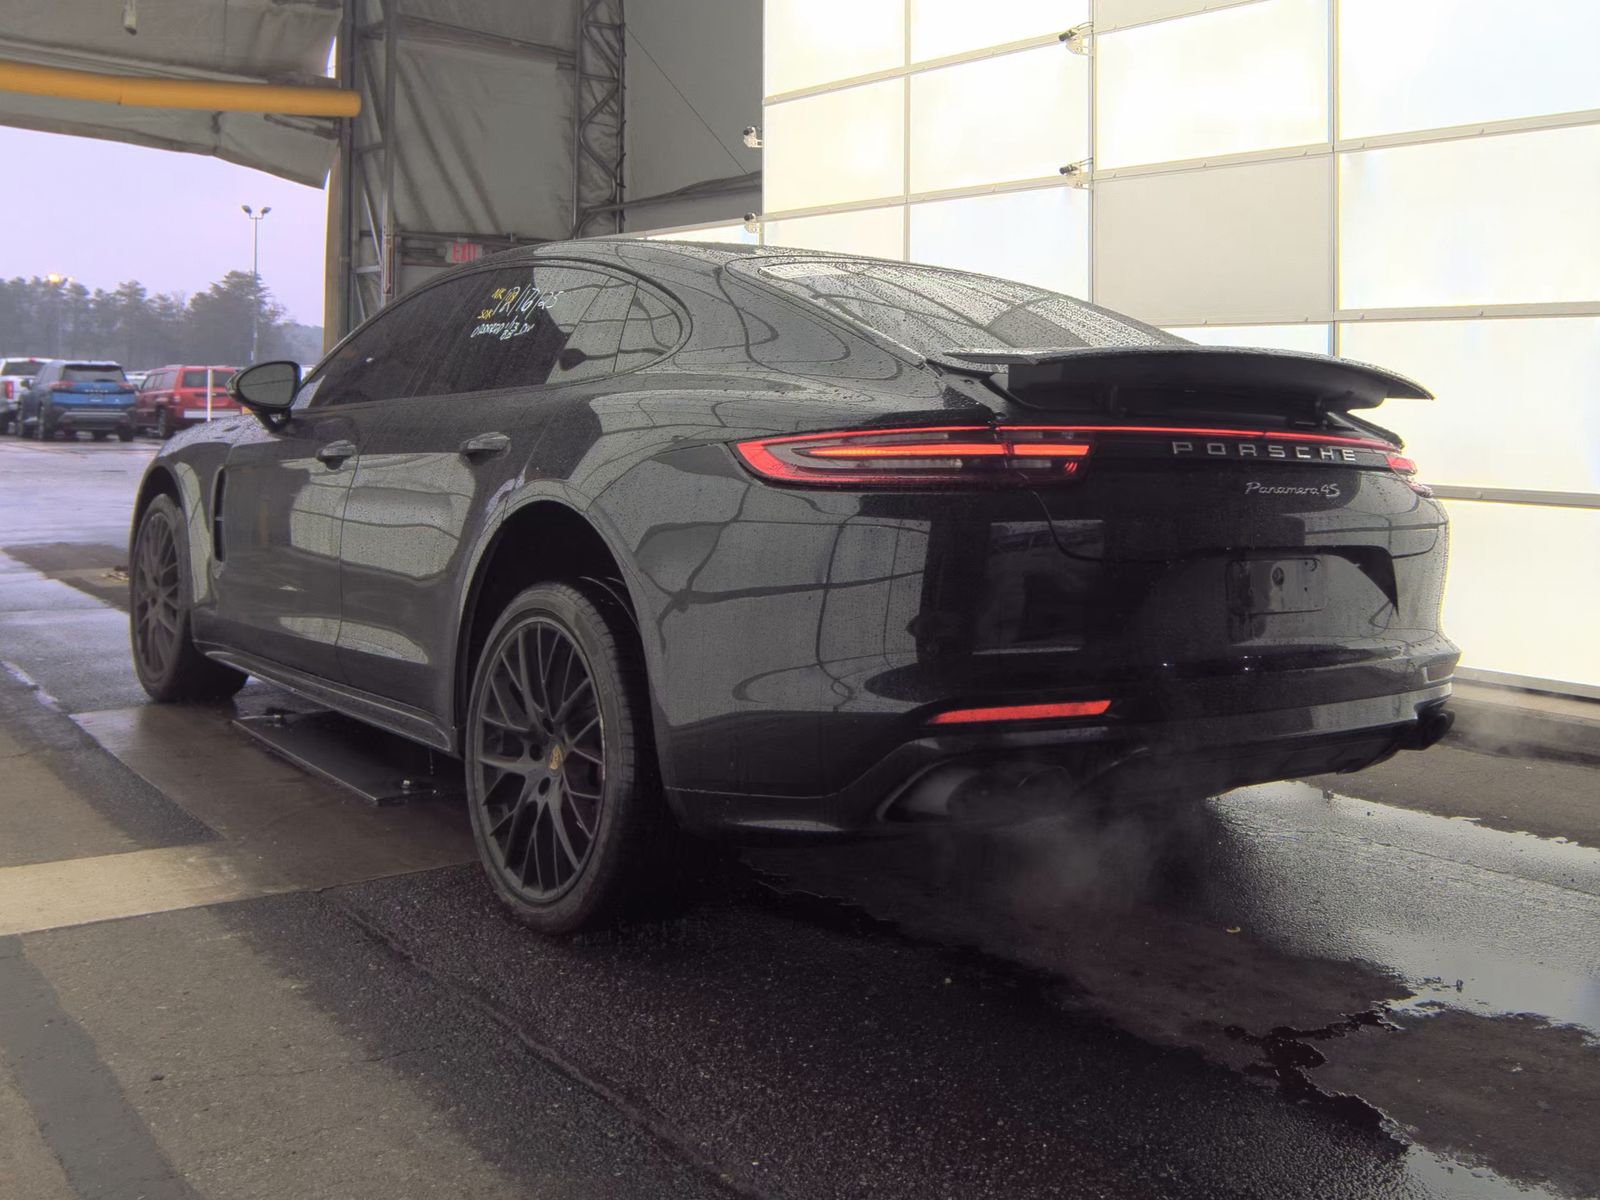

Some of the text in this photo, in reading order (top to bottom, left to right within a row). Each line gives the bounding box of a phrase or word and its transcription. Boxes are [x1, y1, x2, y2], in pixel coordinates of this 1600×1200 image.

[1171, 441, 1357, 462] PORSCHE
[1244, 481, 1341, 498] Panamera 4S
